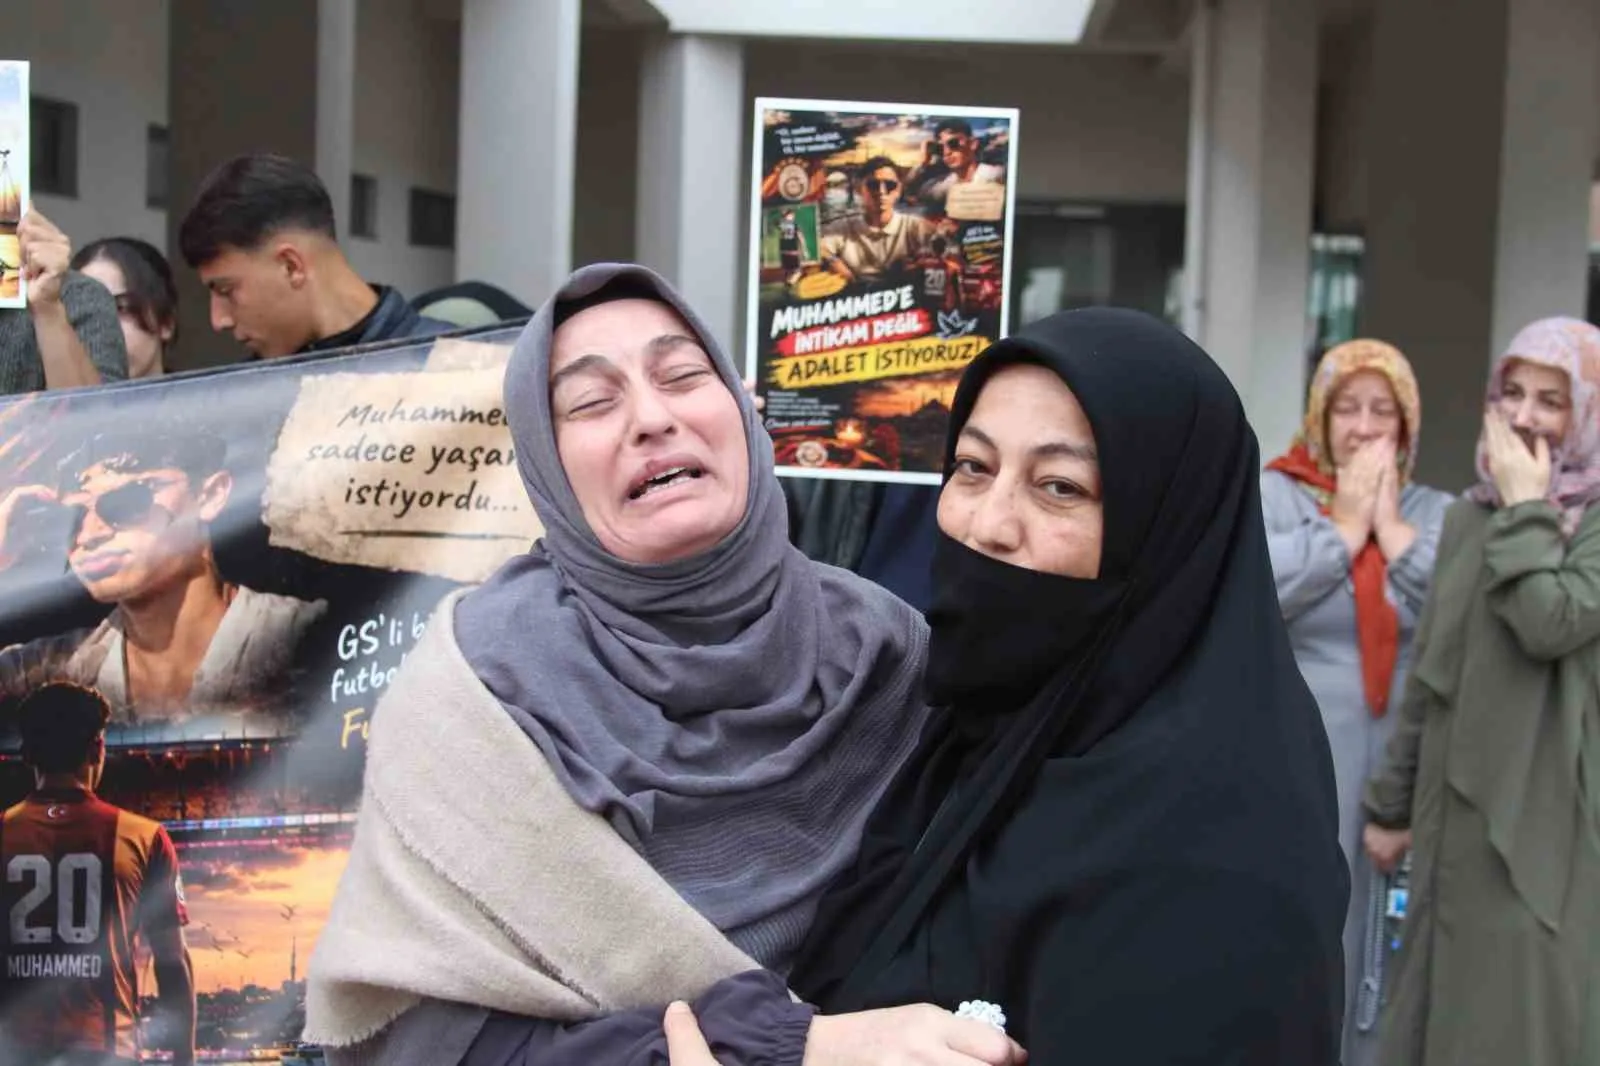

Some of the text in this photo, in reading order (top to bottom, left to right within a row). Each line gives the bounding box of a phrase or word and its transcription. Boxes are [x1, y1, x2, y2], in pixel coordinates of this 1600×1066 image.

[770, 285, 915, 339] MUHAMMED'E
[795, 311, 923, 354] İNTİKAM DEĞİL
[788, 339, 981, 381] ADALET İSTİYORUZ!
[306, 434, 415, 462] sadece
[344, 478, 519, 519] istiyordu...
[337, 613, 404, 661] GS'li
[7, 852, 102, 944] 20
[8, 953, 102, 979] MUHAMMED
